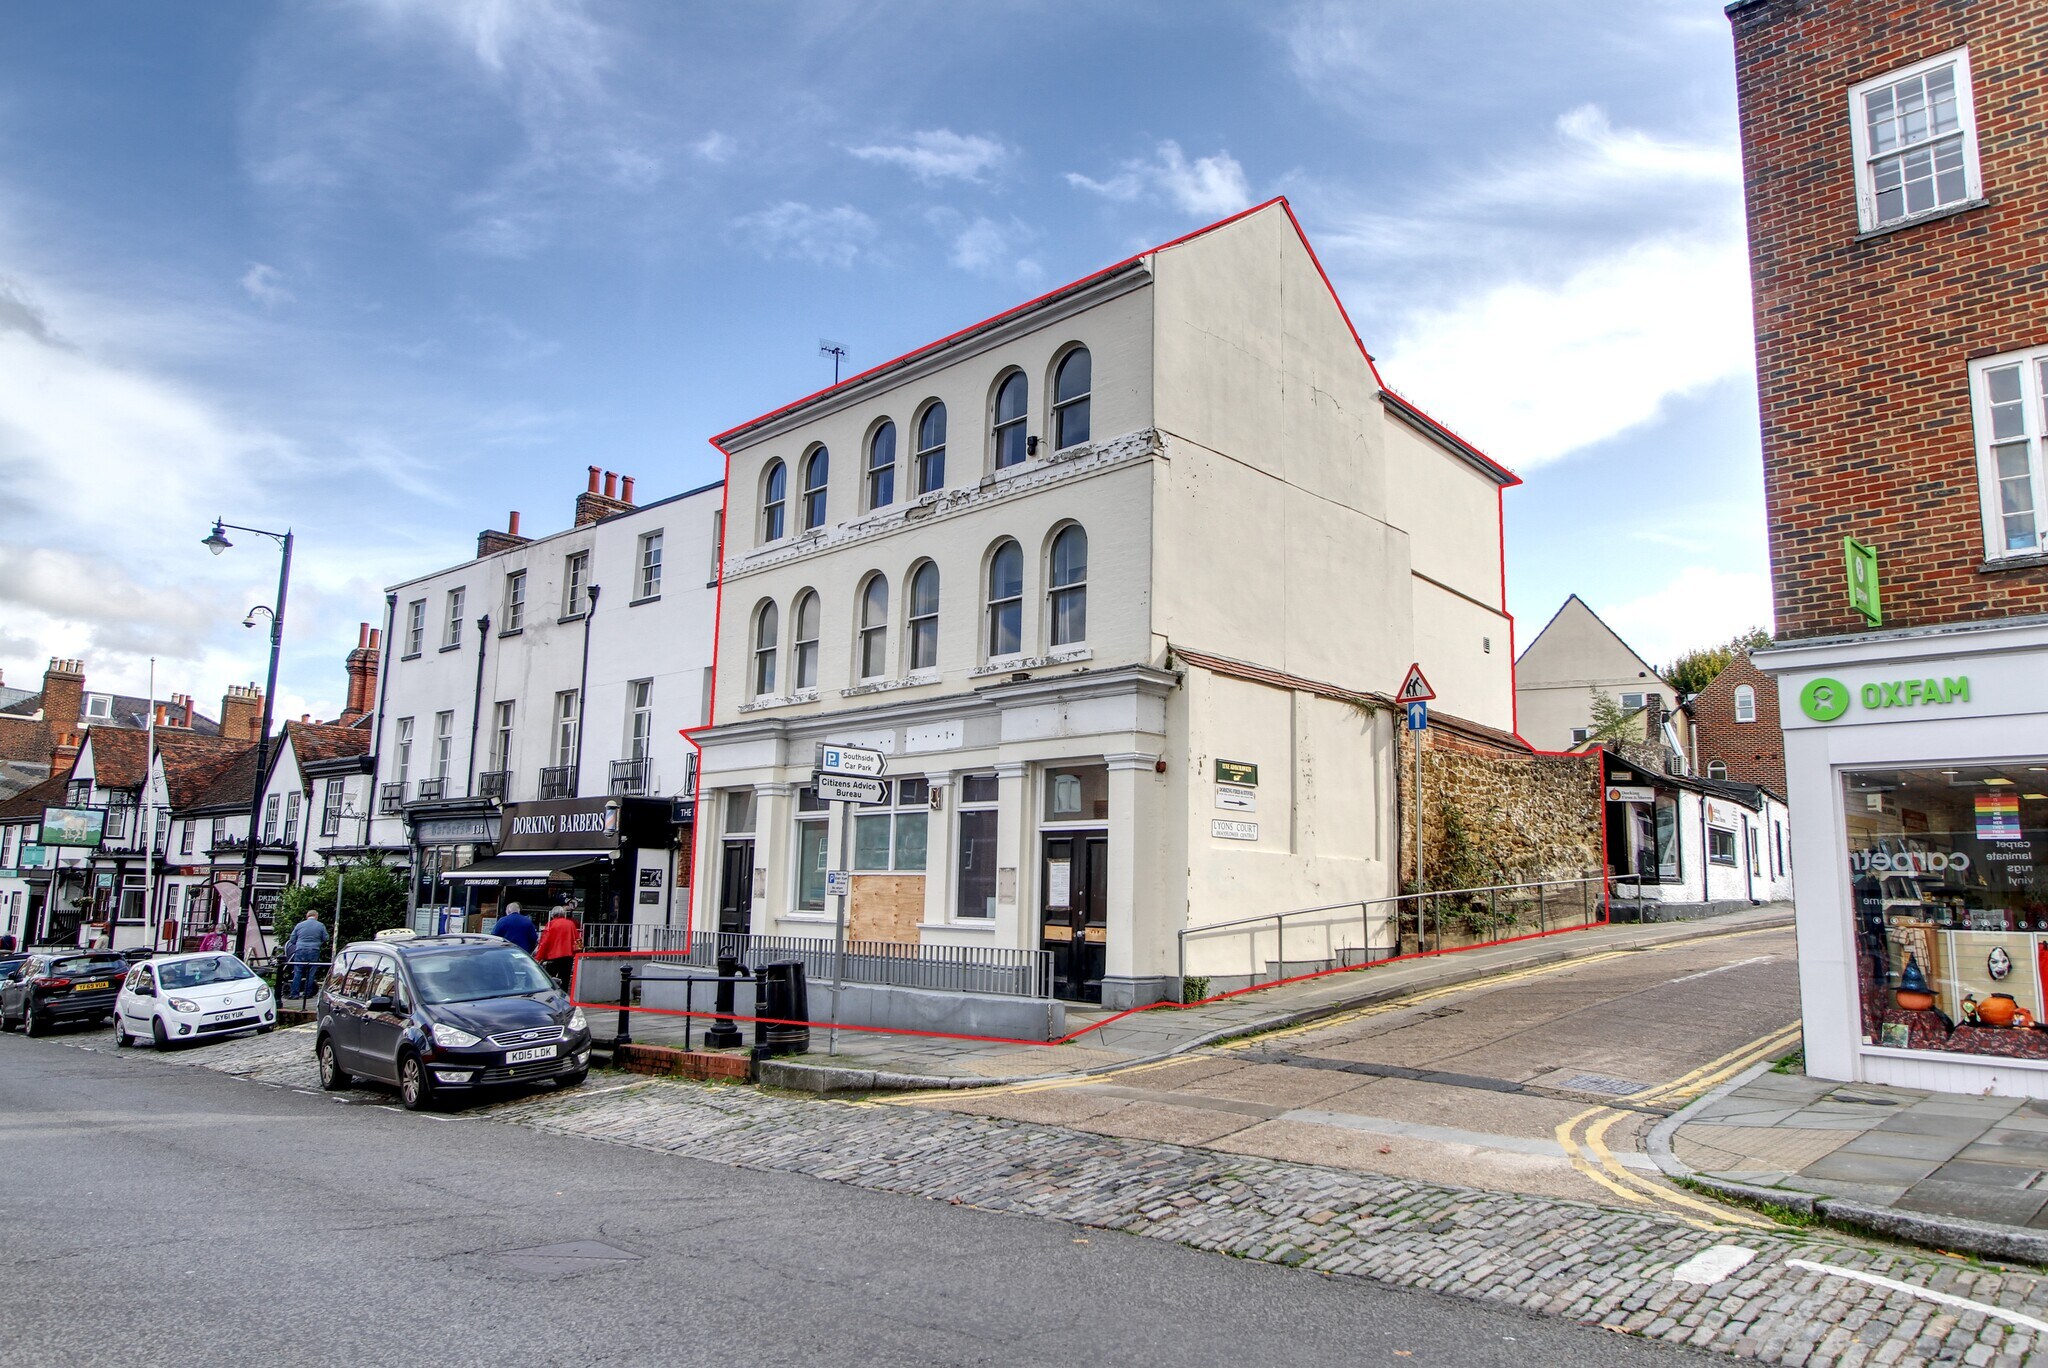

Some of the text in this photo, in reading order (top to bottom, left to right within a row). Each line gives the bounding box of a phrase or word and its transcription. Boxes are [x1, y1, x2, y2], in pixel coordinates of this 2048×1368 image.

[1861, 676, 1970, 709] OXFAM
[843, 752, 875, 763] Southside
[844, 762, 856, 770] Car
[857, 763, 872, 772] Park
[821, 778, 877, 791] Citizens Advice
[836, 789, 862, 798] Bureau
[680, 808, 692, 817] THE
[513, 812, 605, 834] DORKING BARBERS
[1213, 821, 1256, 833] LYONS COURT
[472, 825, 485, 834] 136
[215, 1011, 245, 1021] GY61 YUK
[511, 1047, 552, 1061] KD15 LDK
